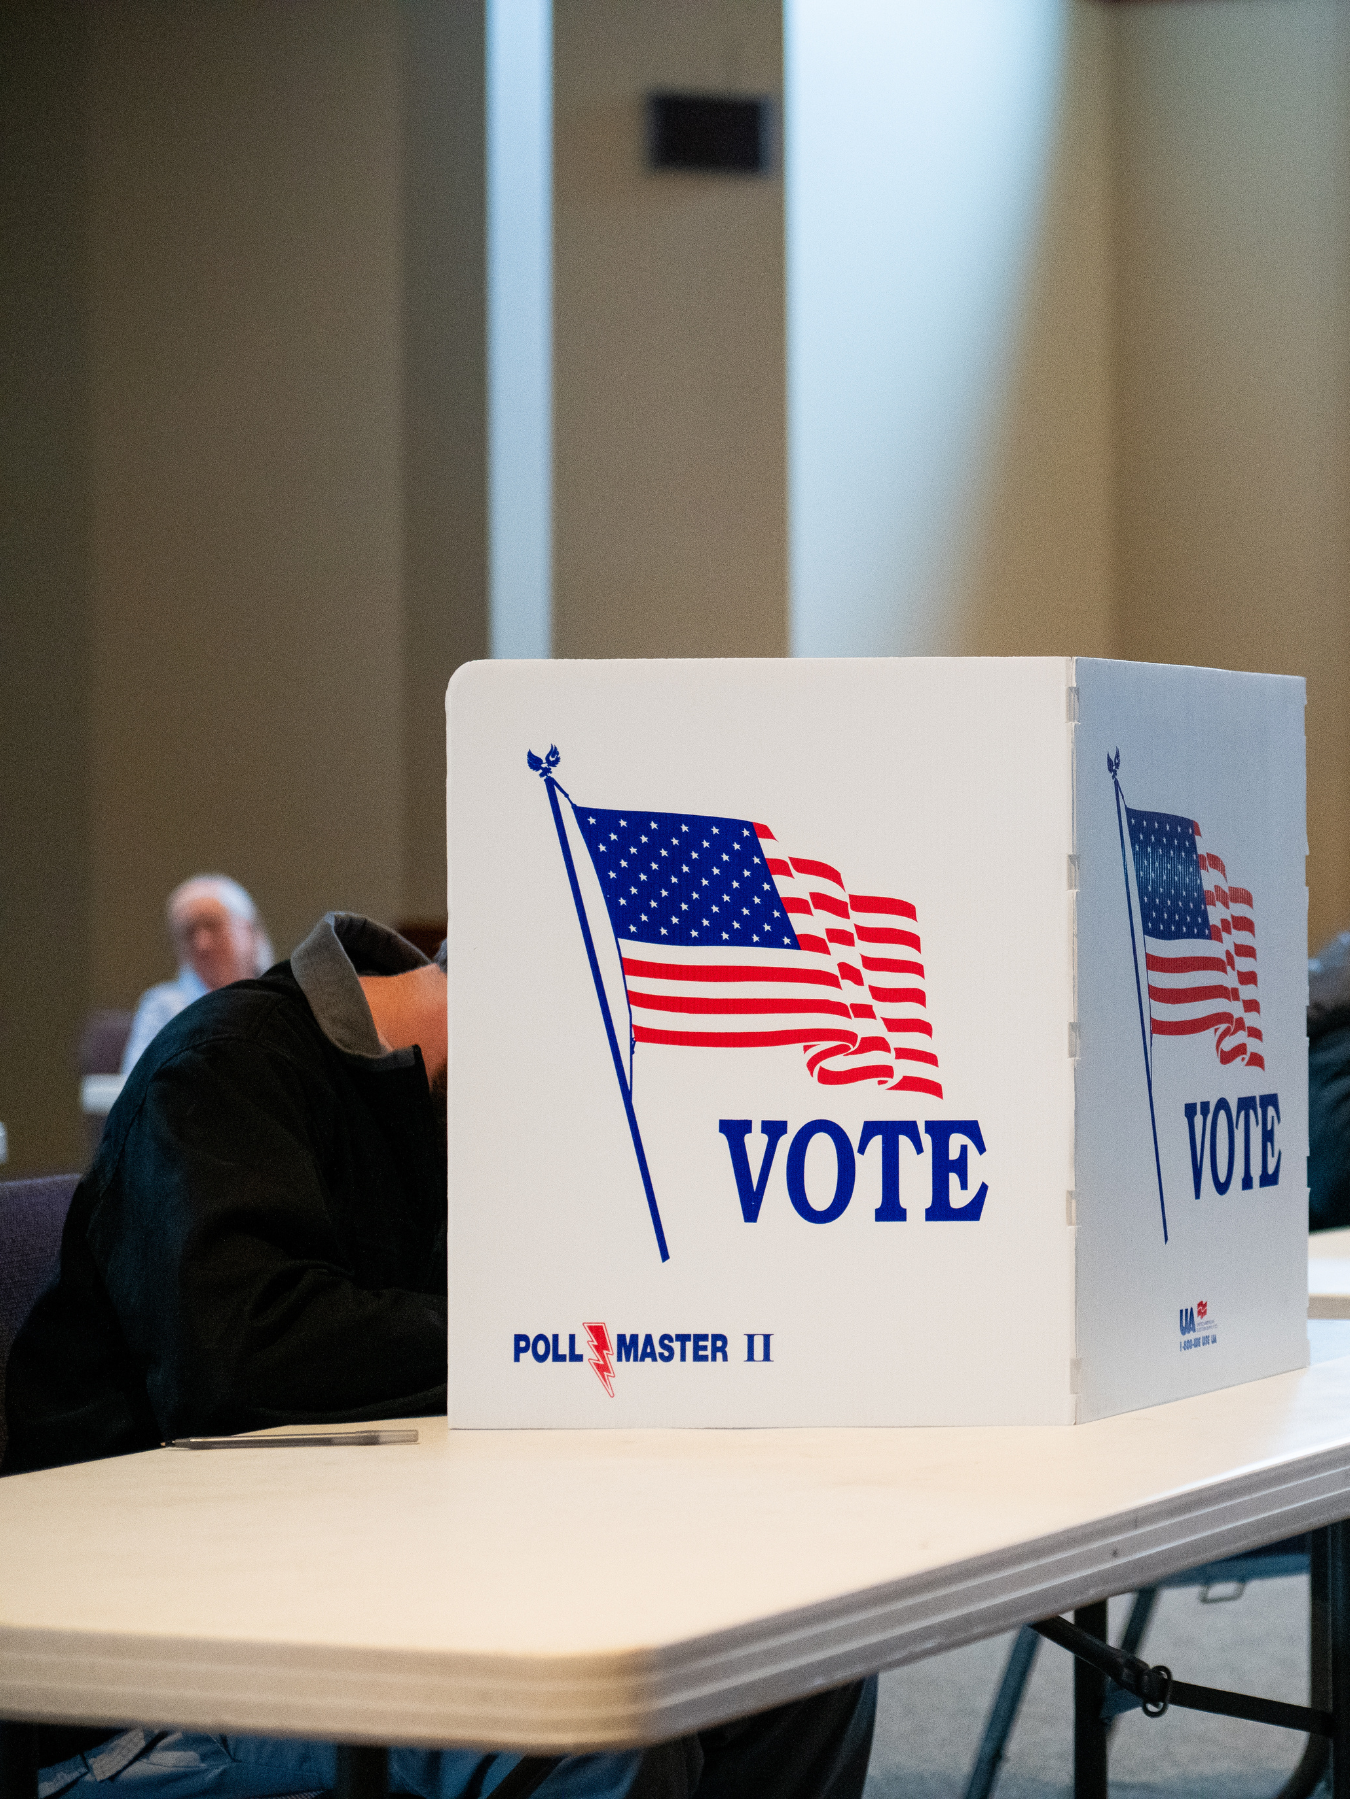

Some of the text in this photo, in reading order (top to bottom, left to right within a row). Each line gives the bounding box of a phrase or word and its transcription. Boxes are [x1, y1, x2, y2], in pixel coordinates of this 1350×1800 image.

[718, 1118, 989, 1224] VOTE
[1184, 1093, 1282, 1200] VOTE
[513, 1333, 775, 1363] POLL MASTER II
[1179, 1306, 1196, 1336] UA
